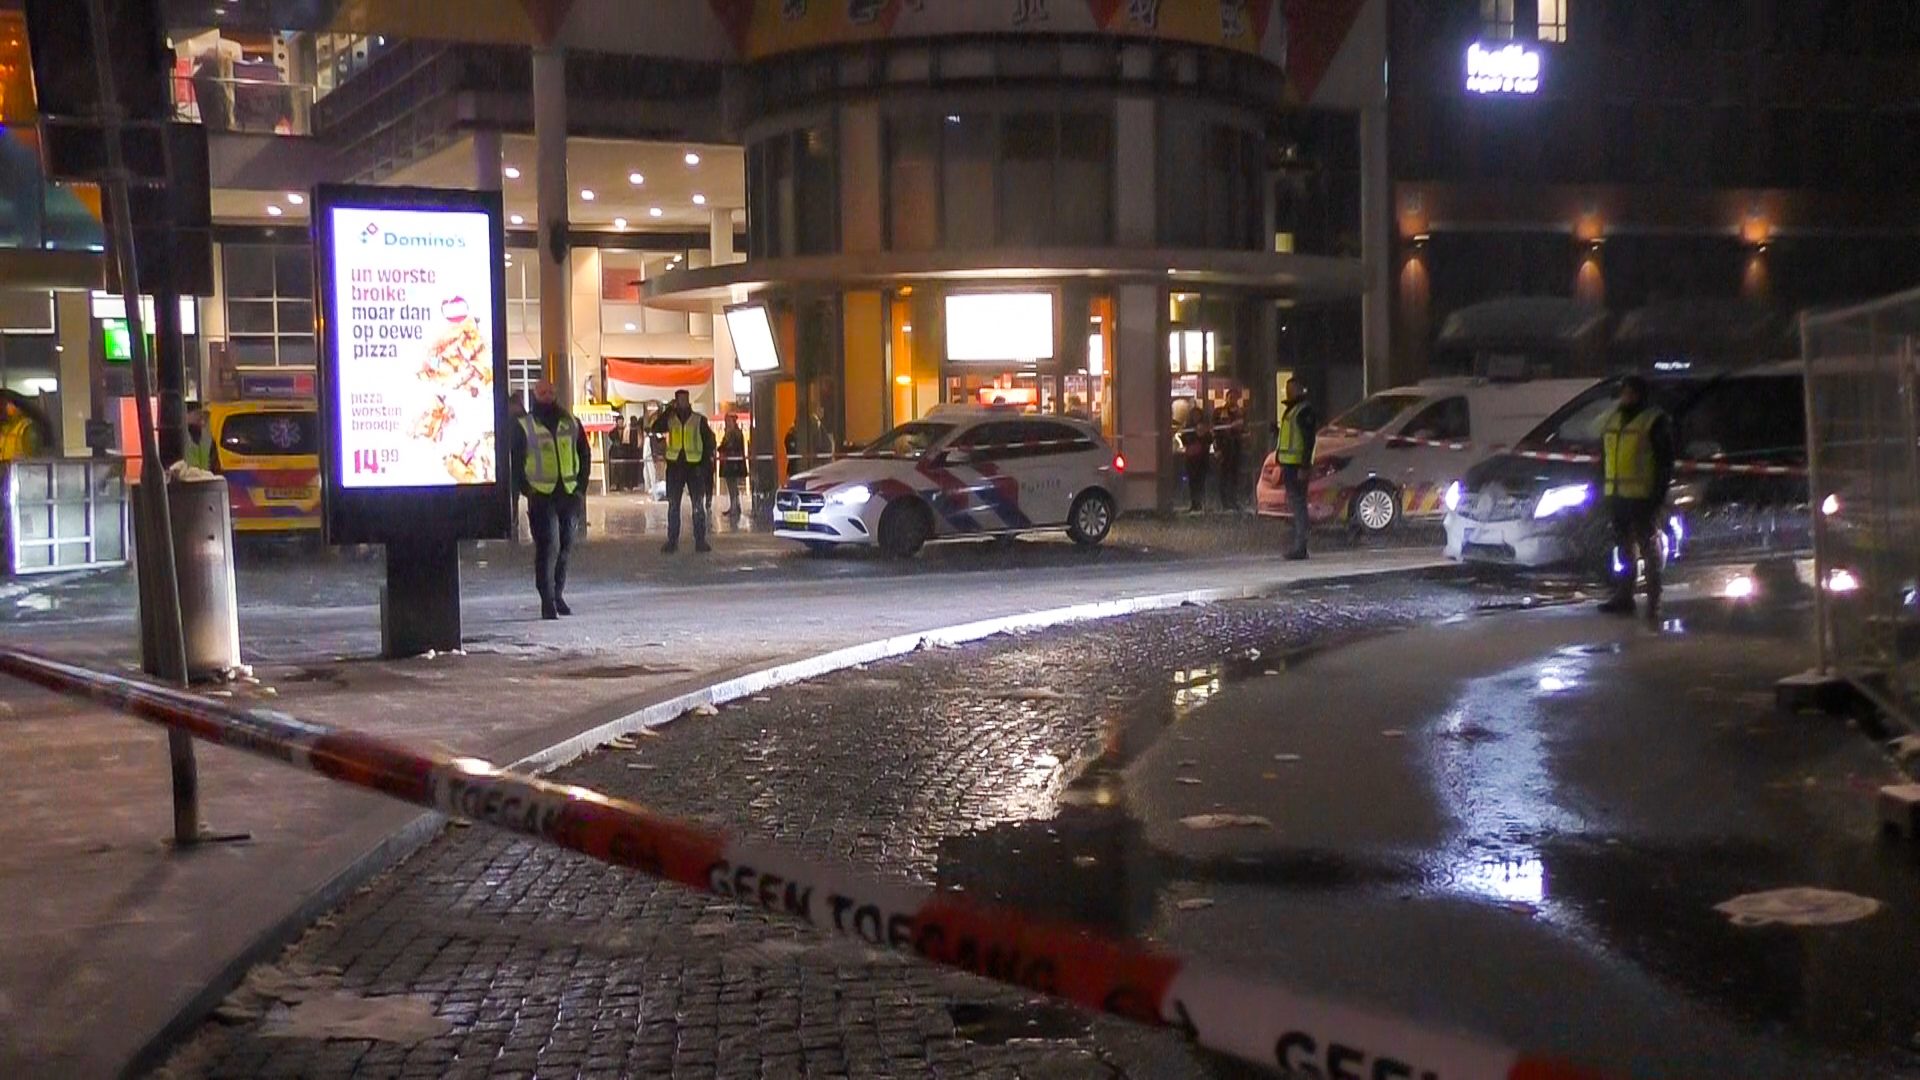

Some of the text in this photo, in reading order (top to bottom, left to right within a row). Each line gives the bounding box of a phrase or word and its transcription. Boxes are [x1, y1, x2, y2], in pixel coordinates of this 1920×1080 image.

[384, 231, 466, 248] Domino's
[351, 268, 436, 284] un worste
[352, 285, 406, 301] broike
[352, 304, 431, 320] moar dan
[353, 324, 423, 341] op oewe
[353, 341, 398, 360] pizza
[351, 392, 383, 405] pizza
[706, 857, 814, 926] GEEN
